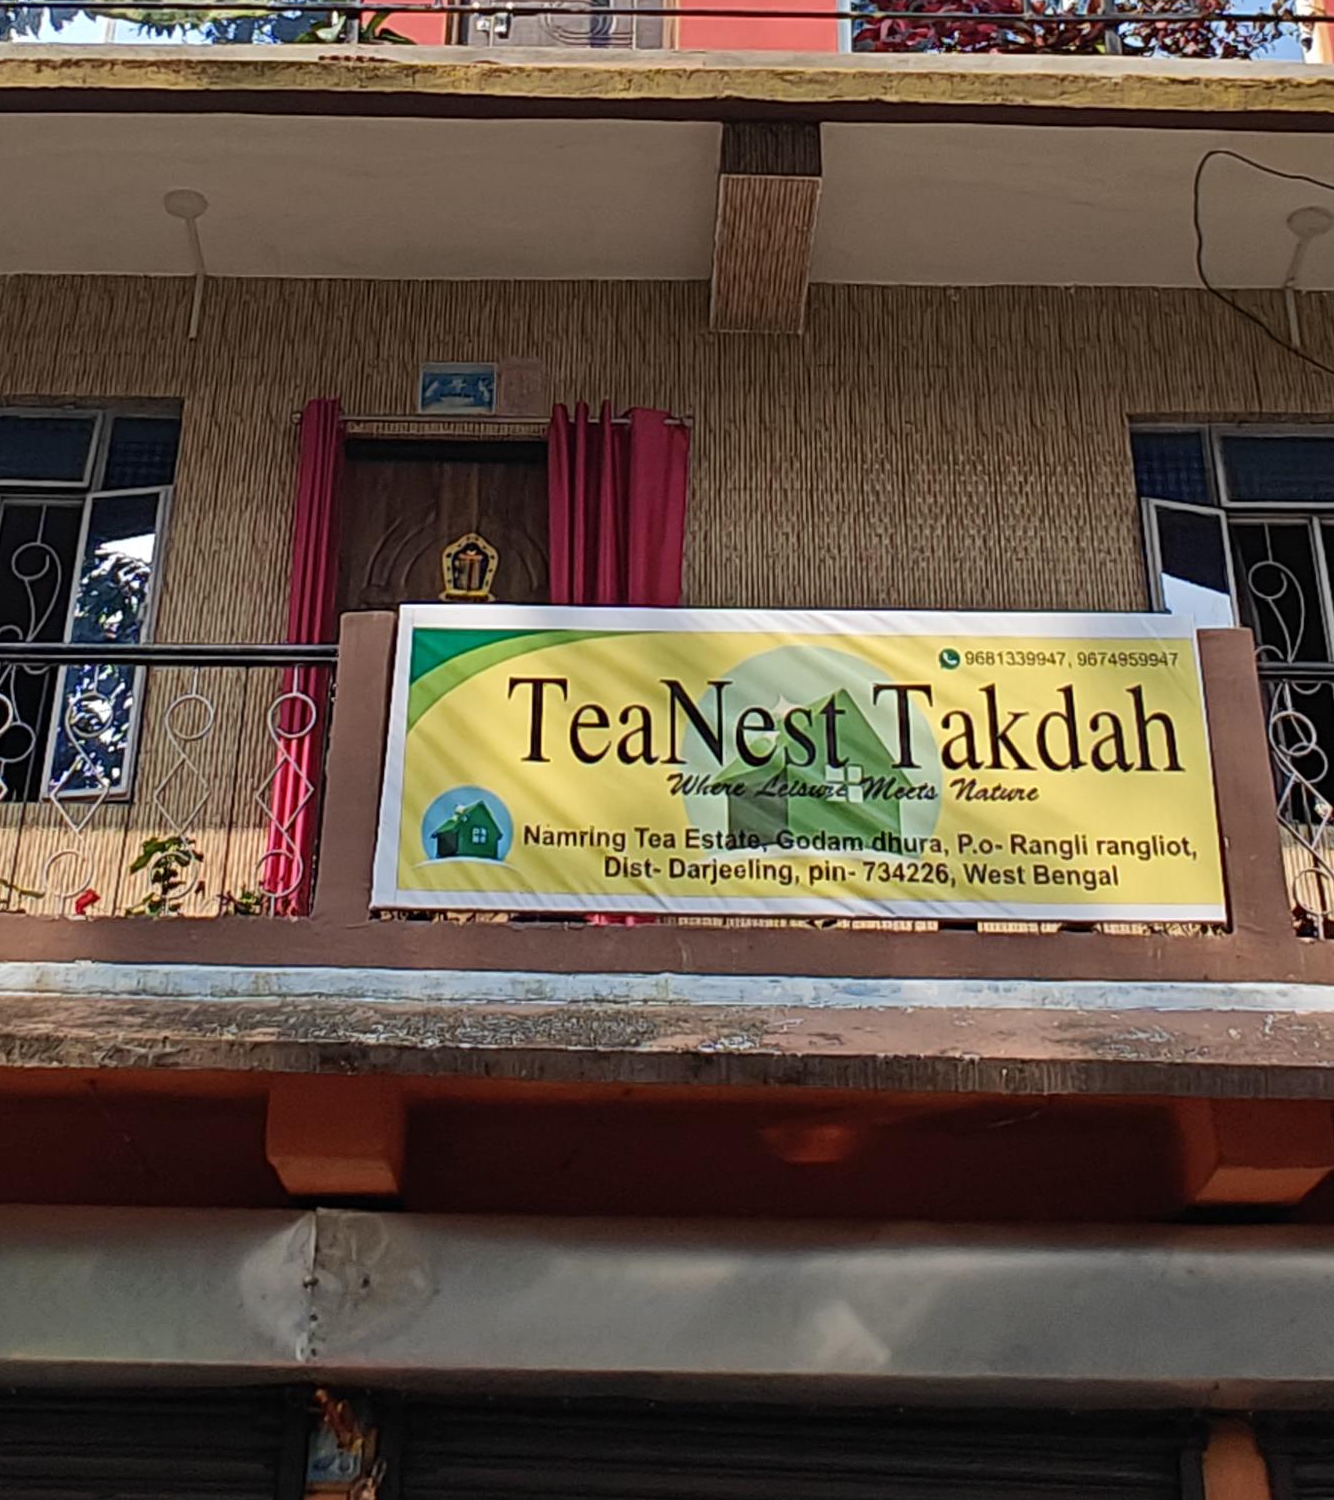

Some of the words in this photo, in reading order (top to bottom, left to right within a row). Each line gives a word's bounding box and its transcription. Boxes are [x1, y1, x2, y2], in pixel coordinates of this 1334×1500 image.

[964, 650, 1072, 668] 9681339947,
[1077, 651, 1179, 668] 9674959947
[507, 676, 851, 768] TeaNest
[872, 682, 1186, 773] Takdah
[666, 772, 746, 798] Where
[755, 774, 848, 799] Leisure
[861, 776, 939, 801] Meets
[949, 777, 1040, 802] Nature
[523, 824, 626, 852] Namring
[633, 827, 676, 848] Tea
[685, 828, 768, 852] Estate,
[775, 829, 863, 851] Godam
[871, 831, 949, 856] dhura,
[957, 833, 1003, 855] P.o-
[1010, 834, 1088, 860] Rangli
[1096, 835, 1198, 861] rangliot,
[604, 856, 662, 878] Dist-
[668, 857, 800, 886] Darjeeling,
[808, 861, 856, 886] pin-
[862, 861, 957, 887] 734226,
[963, 863, 1027, 886] West
[1033, 864, 1119, 891] Bengal
